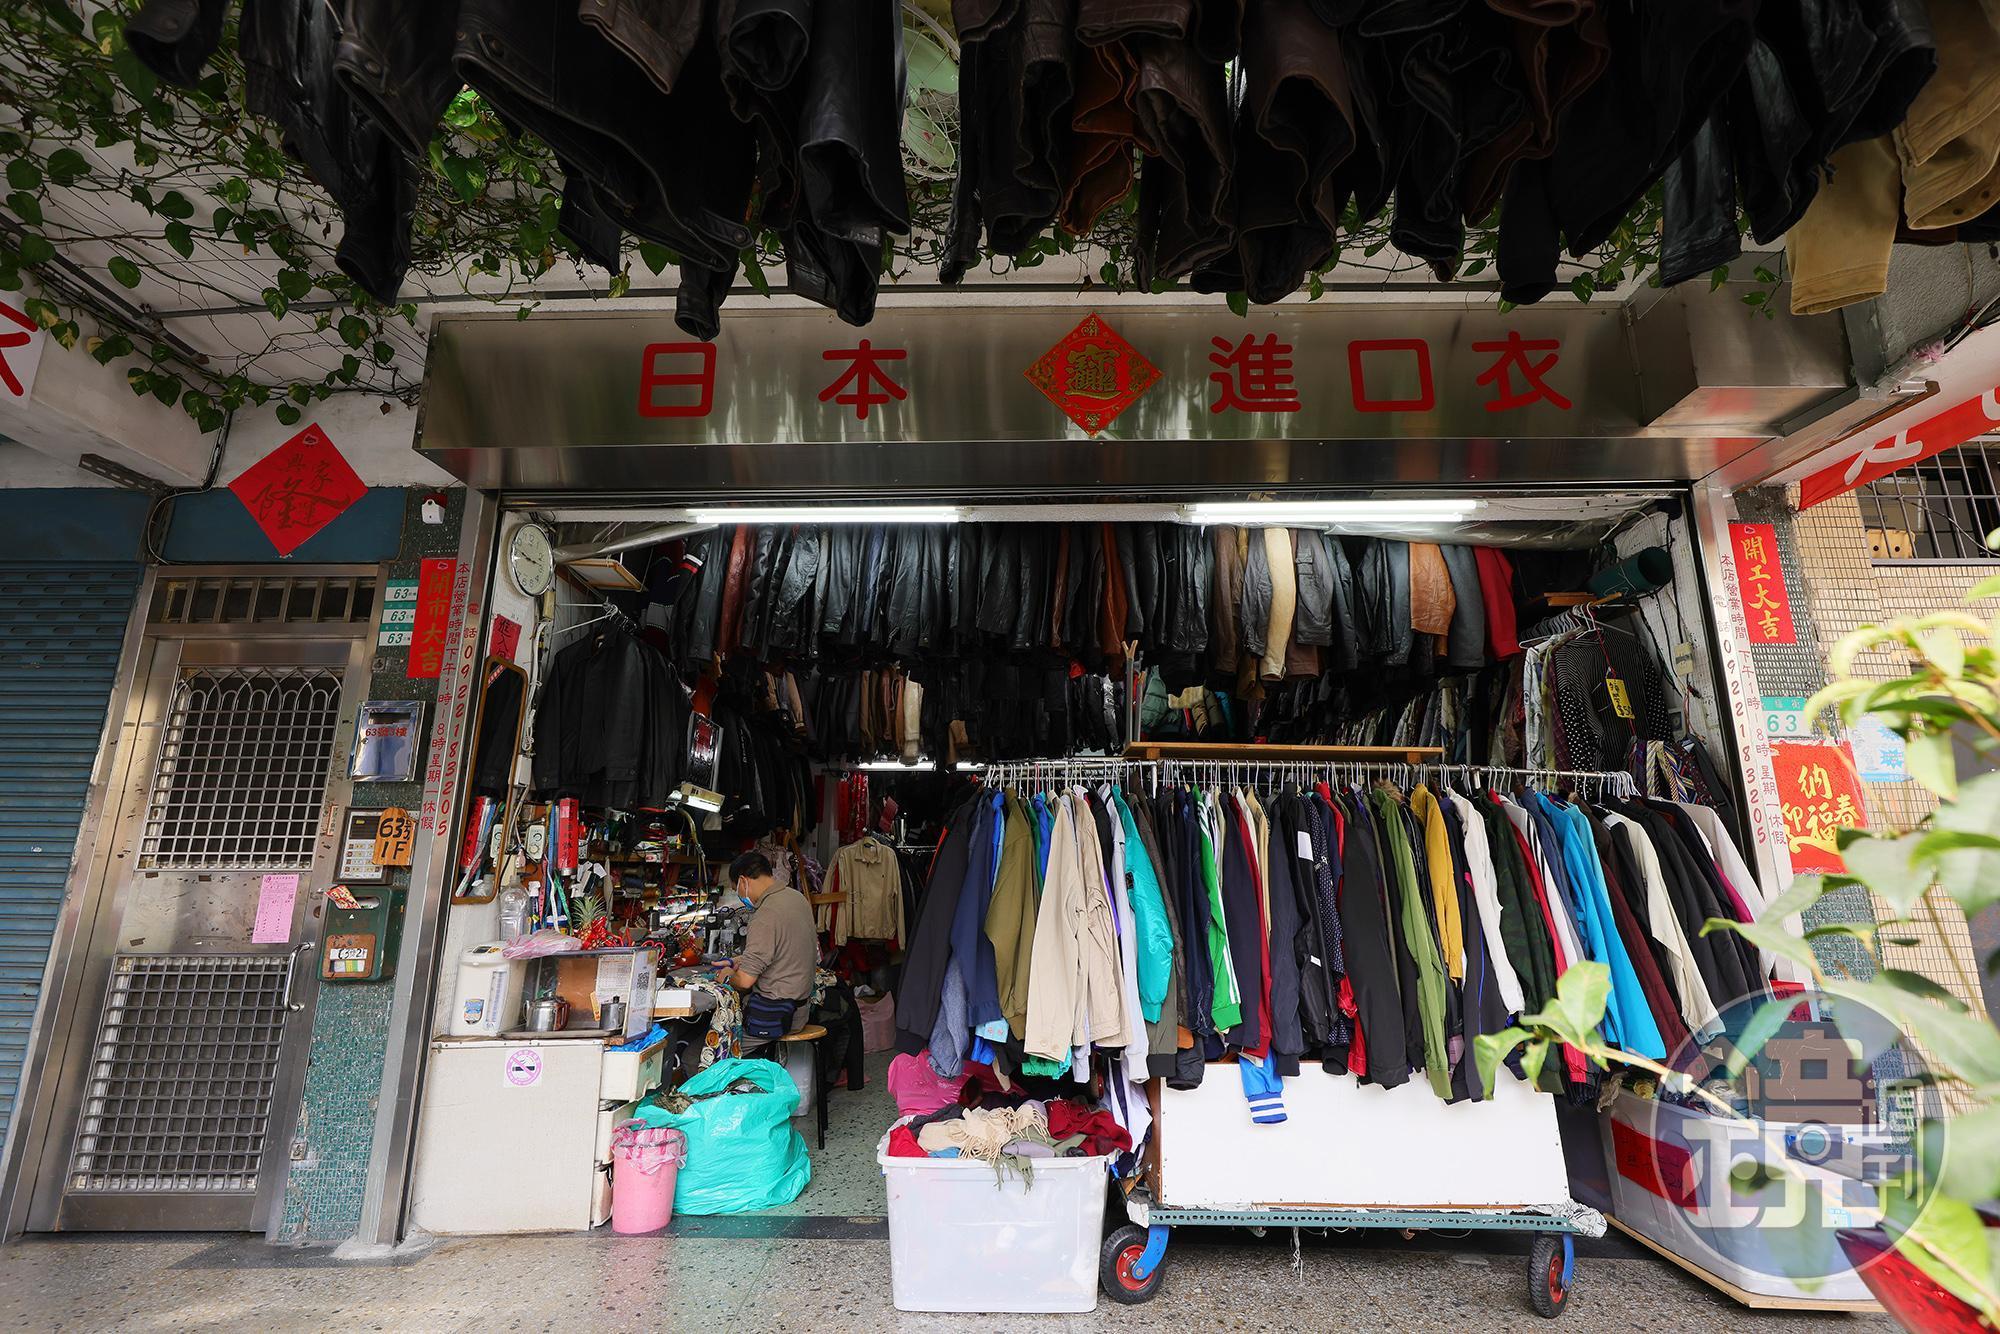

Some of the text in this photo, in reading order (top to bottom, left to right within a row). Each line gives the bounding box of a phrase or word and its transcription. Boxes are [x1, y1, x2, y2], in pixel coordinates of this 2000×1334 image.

[1741, 536, 1781, 639] 開工大吉
[421, 570, 452, 673] 開市大吉
[1767, 714, 1797, 732] 63
[381, 841, 407, 860] 1F
